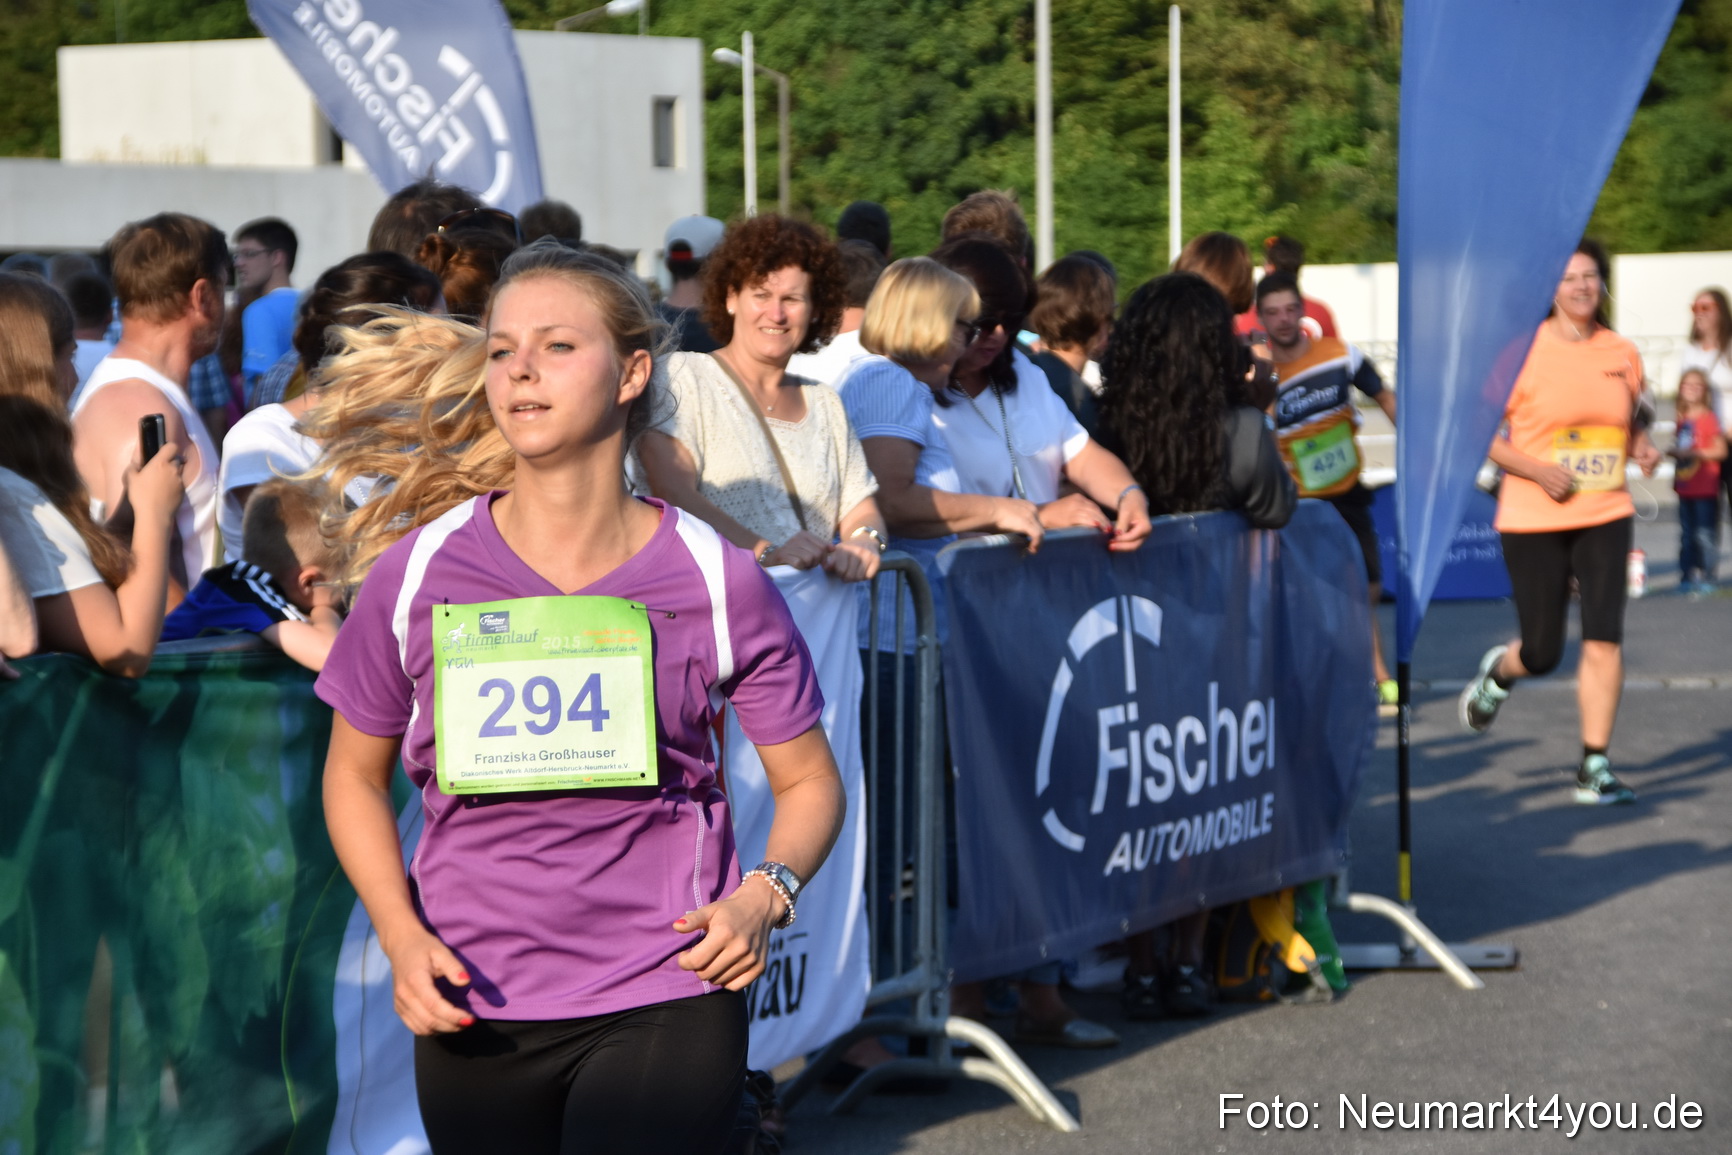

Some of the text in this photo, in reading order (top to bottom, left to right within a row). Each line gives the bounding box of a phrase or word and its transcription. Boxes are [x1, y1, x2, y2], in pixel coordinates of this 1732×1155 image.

[466, 629, 539, 646] firmenlauf
[541, 636, 581, 649] 2015
[478, 673, 610, 738] 294
[474, 749, 616, 764] Franziska Großhauser
[461, 769, 503, 777] Diakonisches
[524, 764, 616, 773] Altdorf-Hersbruck-Neumarkt
[1104, 792, 1274, 877] AUTOMOBILE
